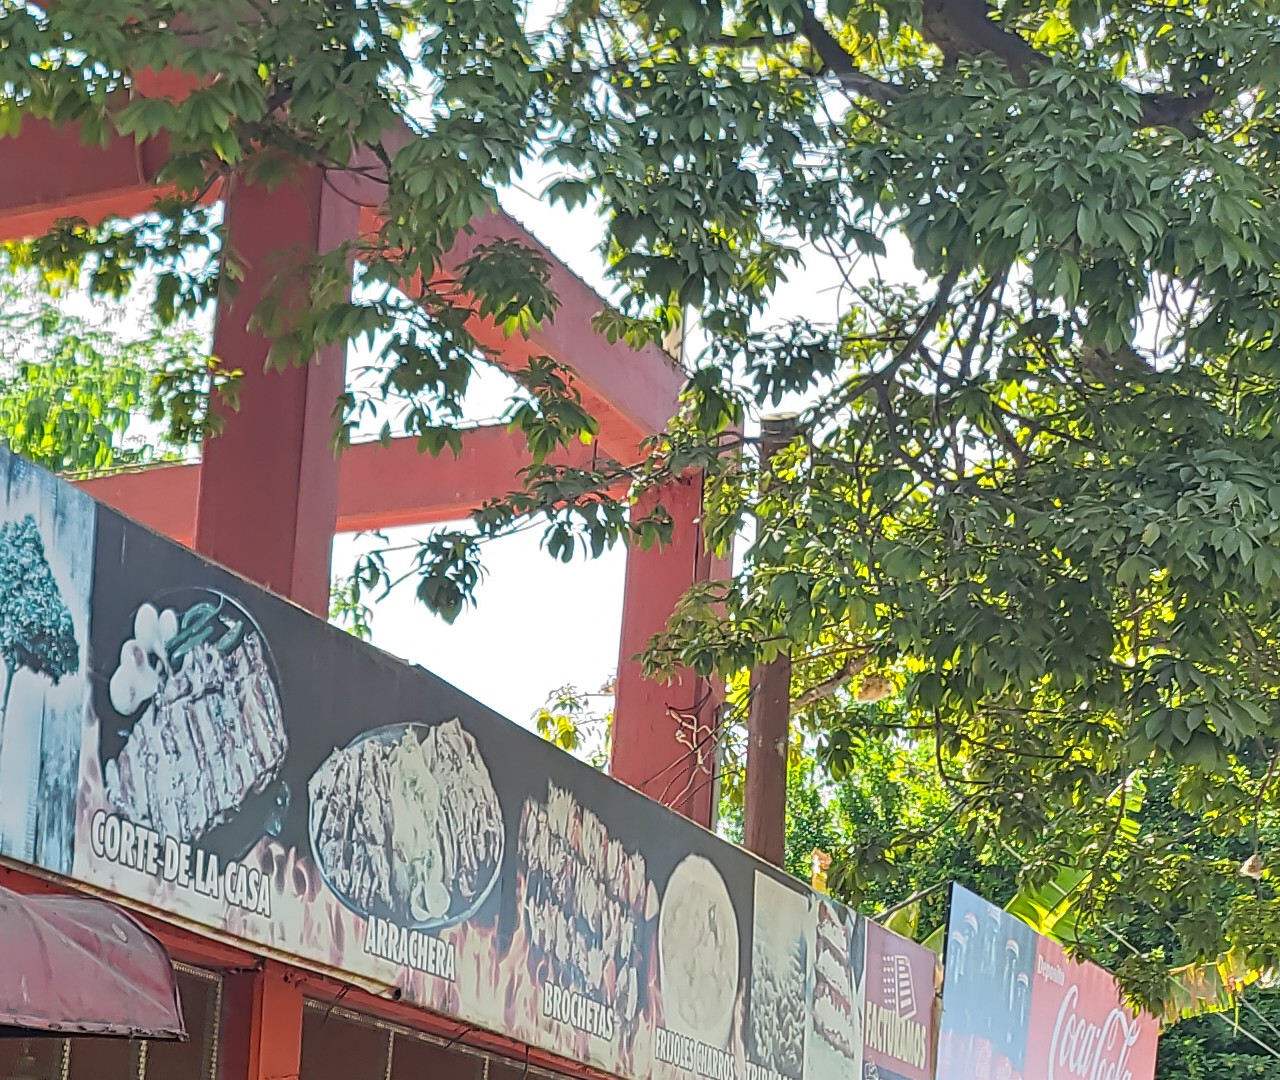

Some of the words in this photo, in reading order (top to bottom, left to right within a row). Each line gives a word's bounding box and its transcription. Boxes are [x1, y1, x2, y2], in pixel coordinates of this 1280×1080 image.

[91, 810, 160, 876] CORTE
[162, 836, 191, 888] DE
[194, 849, 220, 899] LA
[224, 860, 272, 917] CASA
[364, 917, 455, 981] ARRACHERA
[543, 980, 614, 1042] BROCHETAS
[654, 1026, 695, 1072] FRIJOLES
